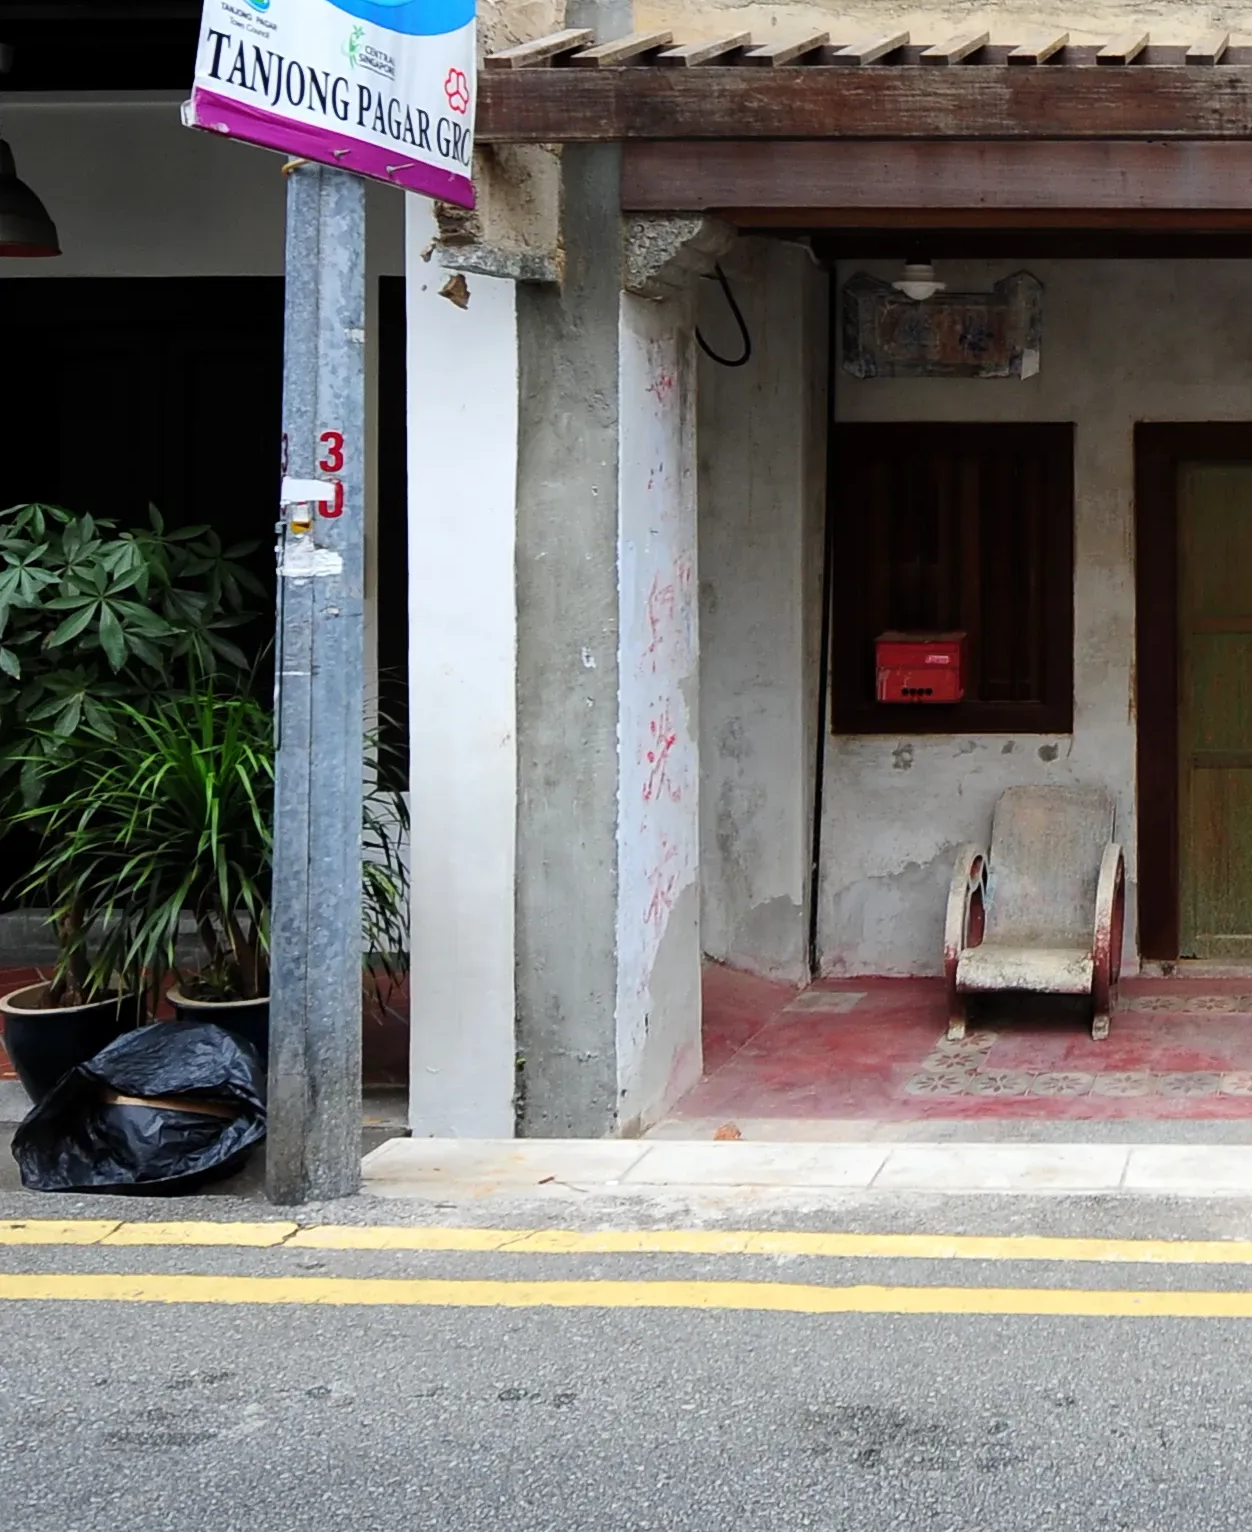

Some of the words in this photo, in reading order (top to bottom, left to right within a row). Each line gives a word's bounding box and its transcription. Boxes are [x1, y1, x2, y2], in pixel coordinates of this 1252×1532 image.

[207, 27, 349, 121] TANJONG
[356, 83, 433, 153] PAGAR
[436, 116, 471, 167] GRC
